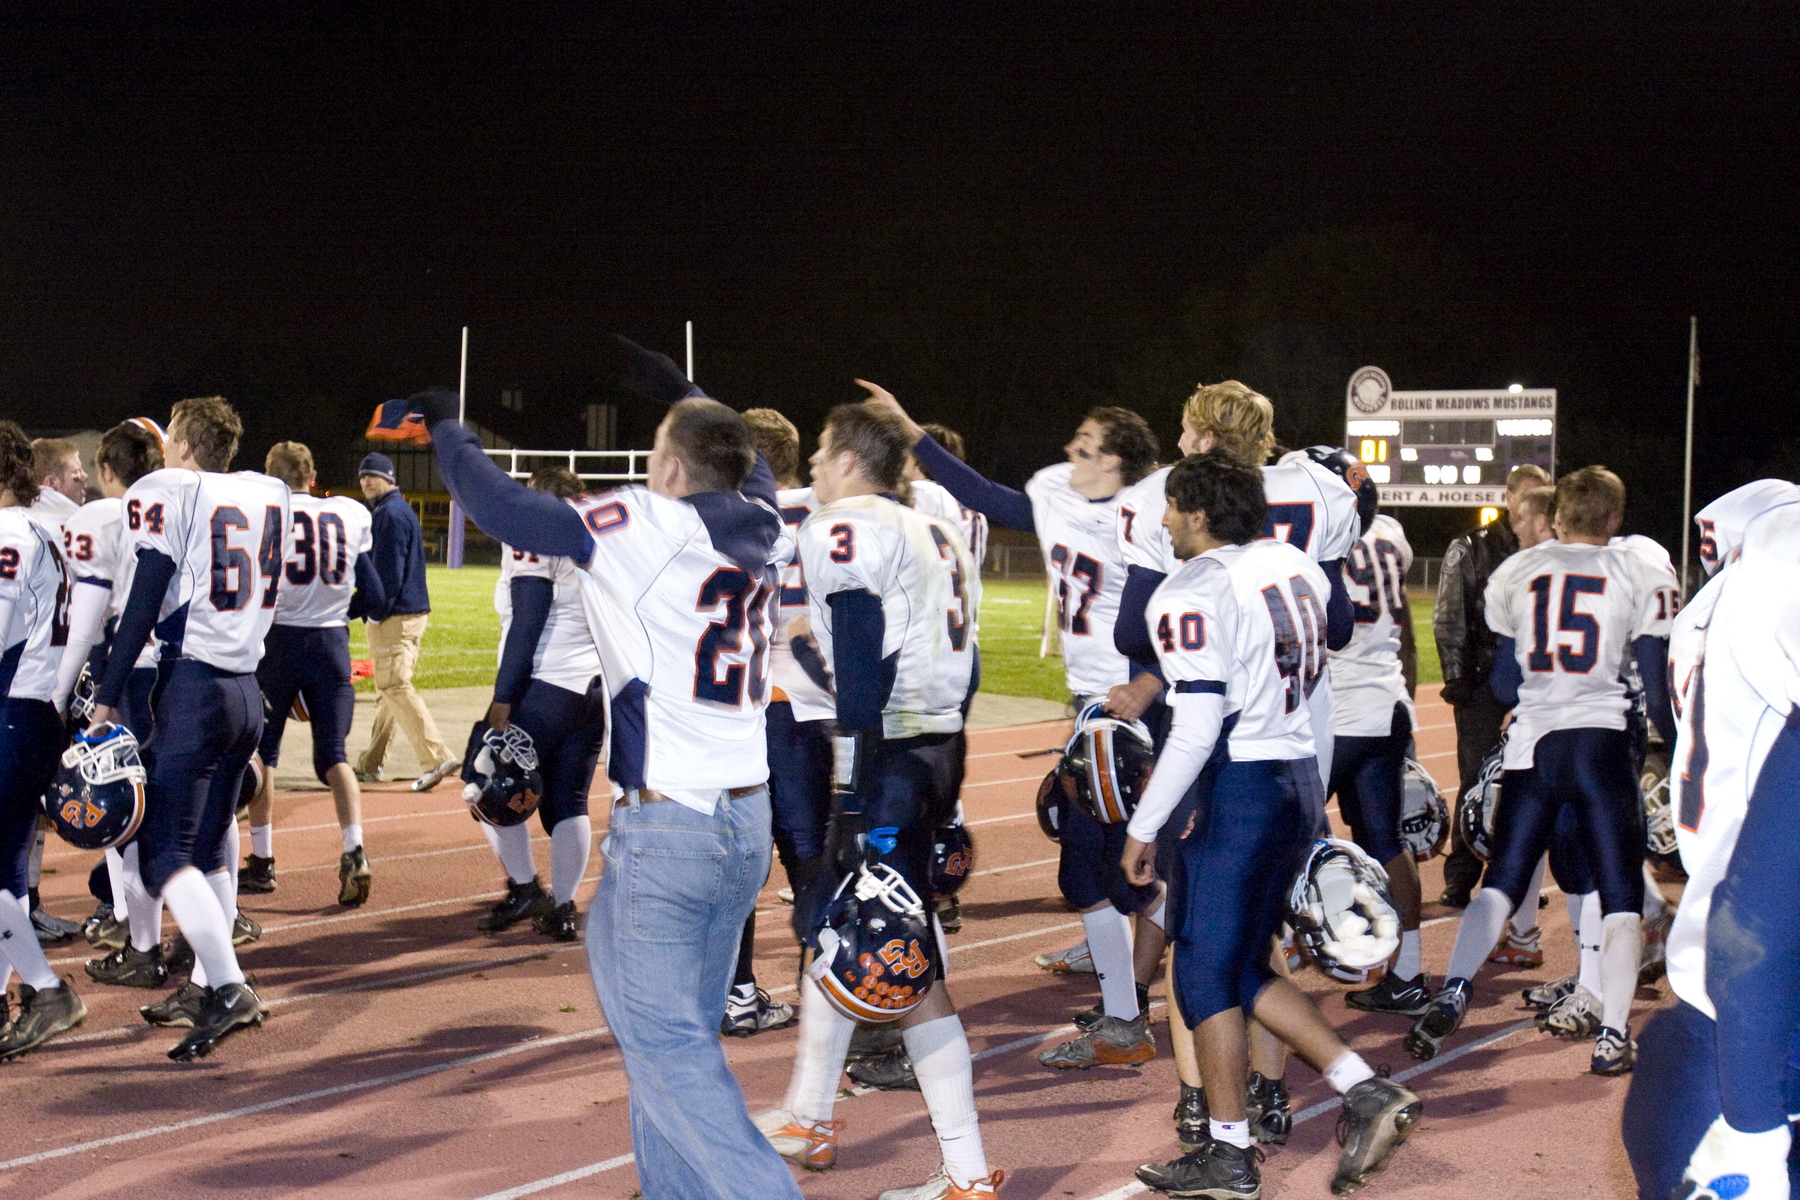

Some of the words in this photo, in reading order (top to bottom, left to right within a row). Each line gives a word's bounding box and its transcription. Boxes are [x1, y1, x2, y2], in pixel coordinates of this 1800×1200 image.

[1391, 398, 1432, 411] ROLLING
[1436, 397, 1490, 410] MEADOWS
[1493, 395, 1553, 409] MUSTANGS
[1376, 490, 1413, 502] ERT
[1439, 490, 1495, 502] HOESE
[126, 499, 165, 535] 64
[1121, 505, 1137, 544] 7
[208, 504, 283, 612] 64
[285, 510, 347, 586] 30
[829, 523, 857, 563] 3
[1157, 611, 1206, 653] 40
[1527, 573, 1607, 674] 15
